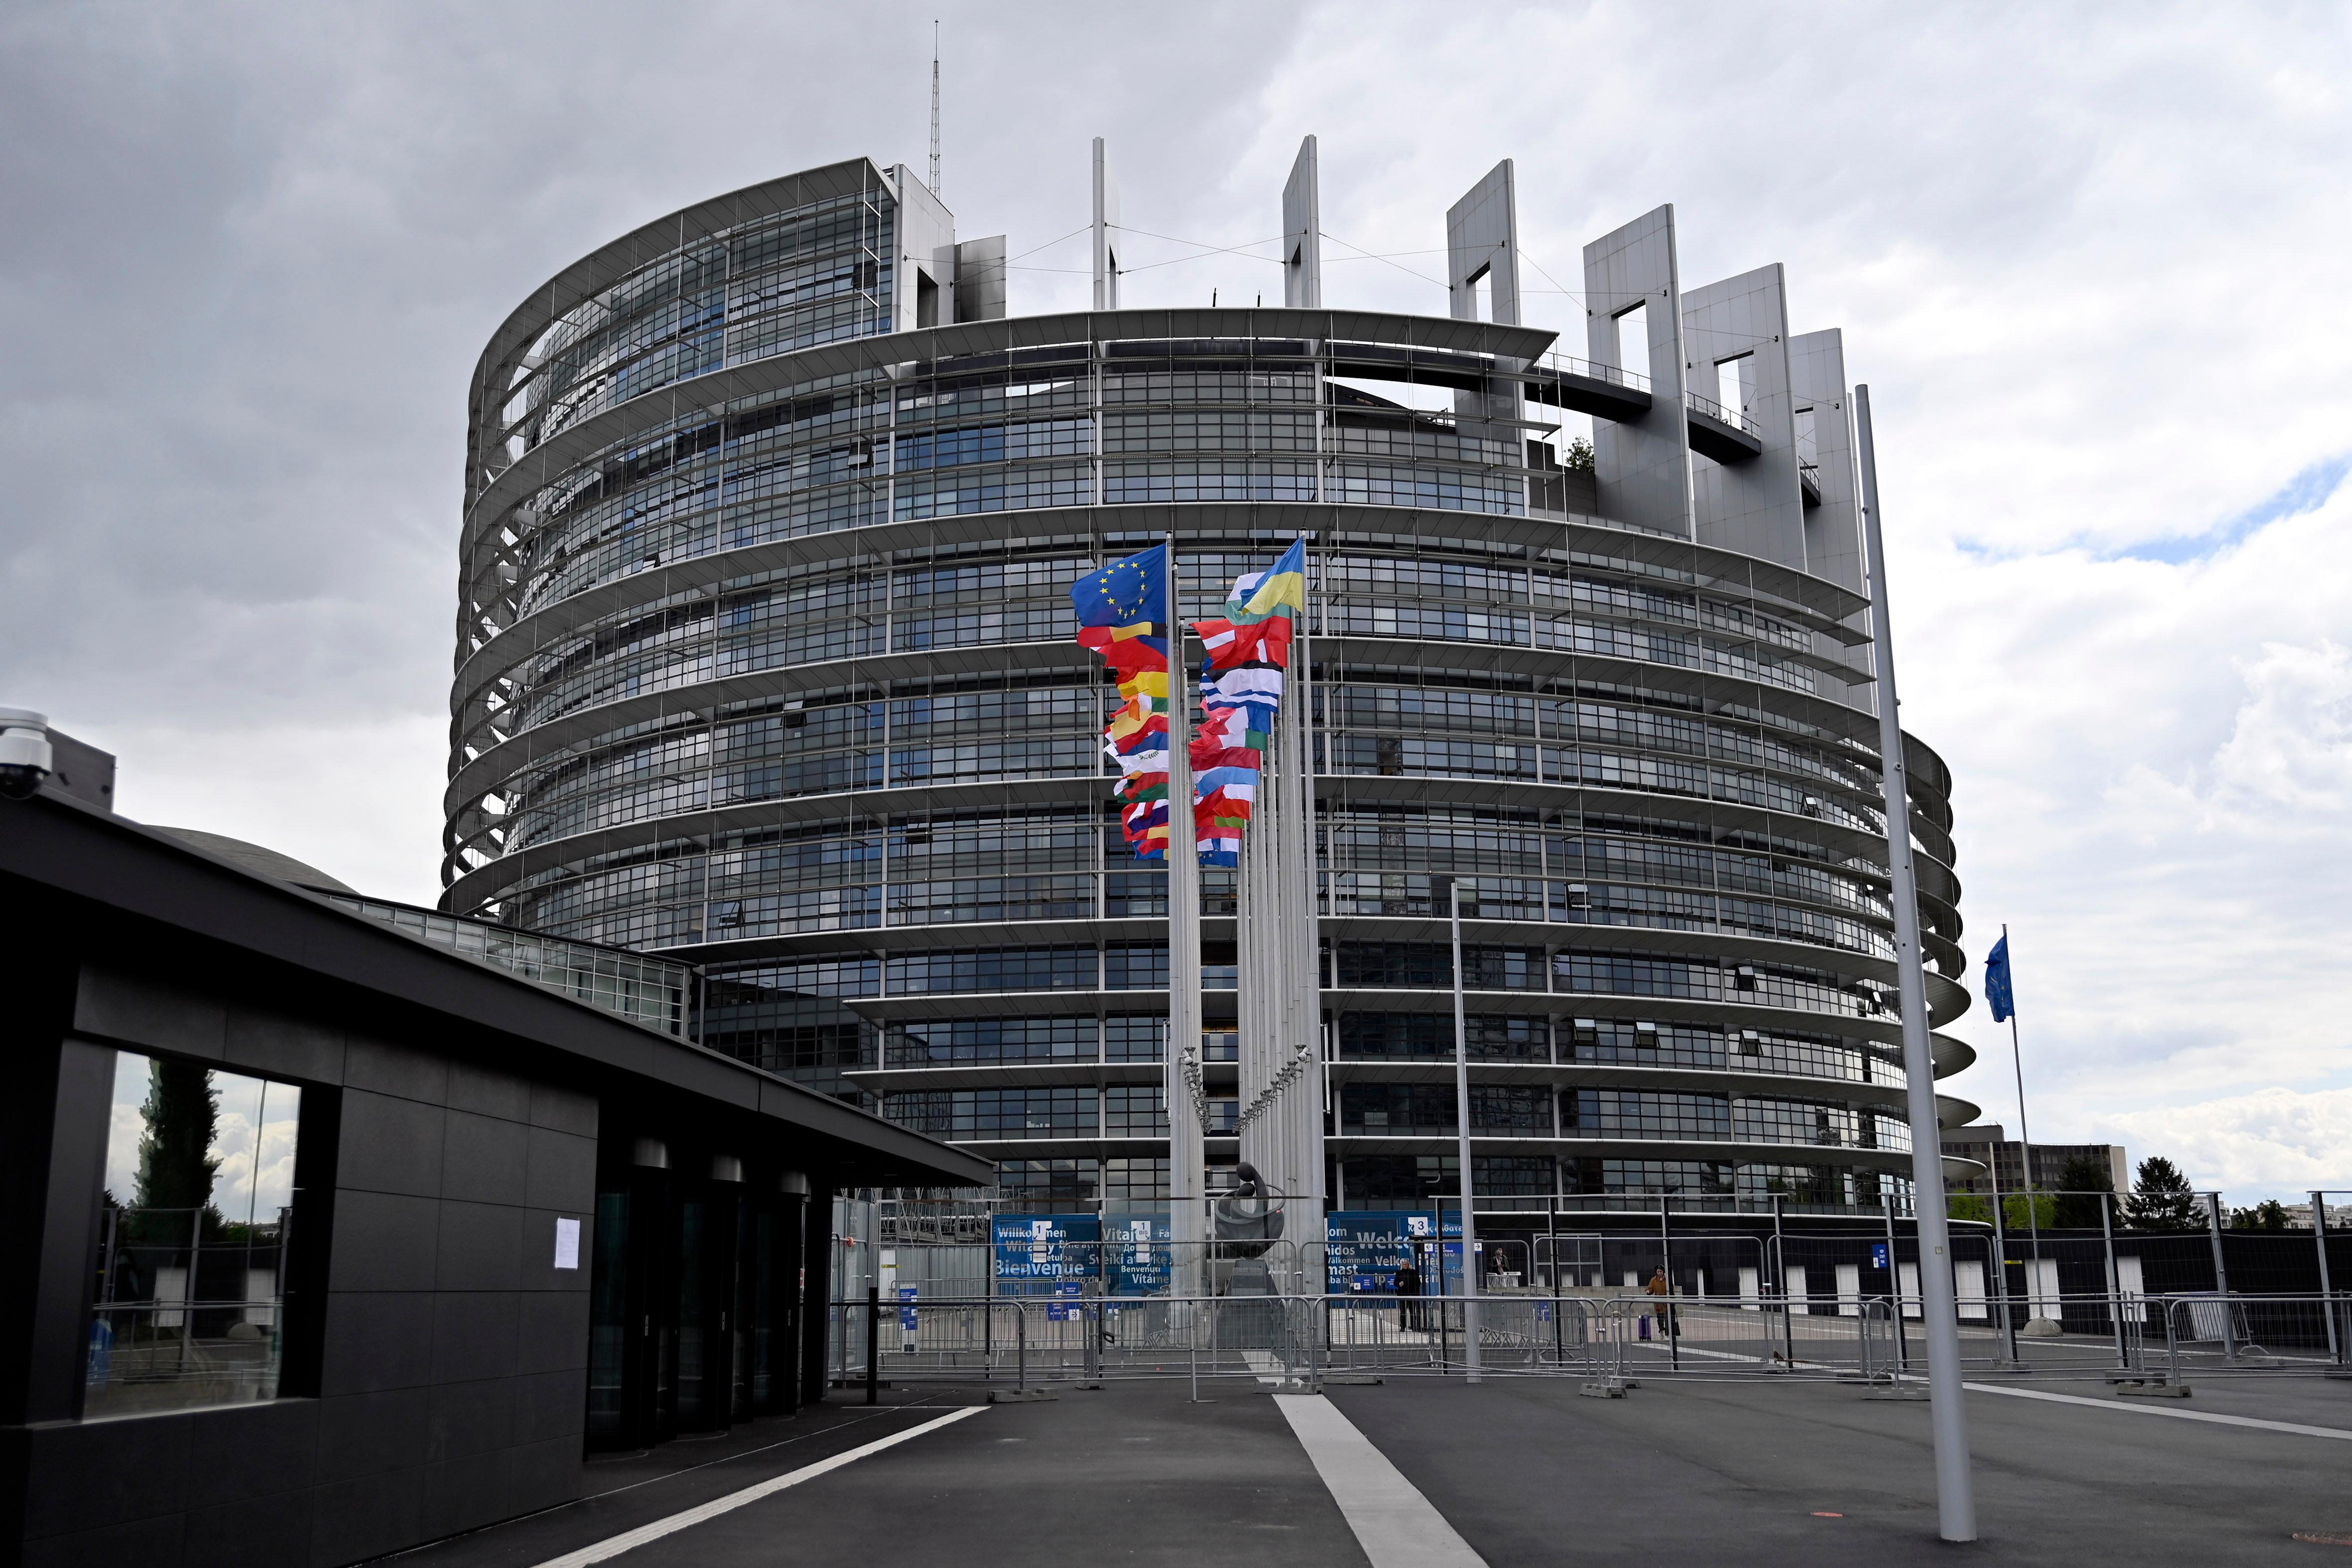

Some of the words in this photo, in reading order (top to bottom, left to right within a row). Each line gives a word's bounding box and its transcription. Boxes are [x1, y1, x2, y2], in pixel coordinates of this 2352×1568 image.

[1036, 1224, 1041, 1234] 1
[1418, 1221, 1424, 1230] 3
[998, 1227, 1066, 1237] Willkomen
[1102, 1227, 1137, 1241] Vitajt
[1005, 1240, 1055, 1254] Witay
[996, 1259, 1084, 1275] Bienvenue
[1132, 1273, 1170, 1284] Vítáme
